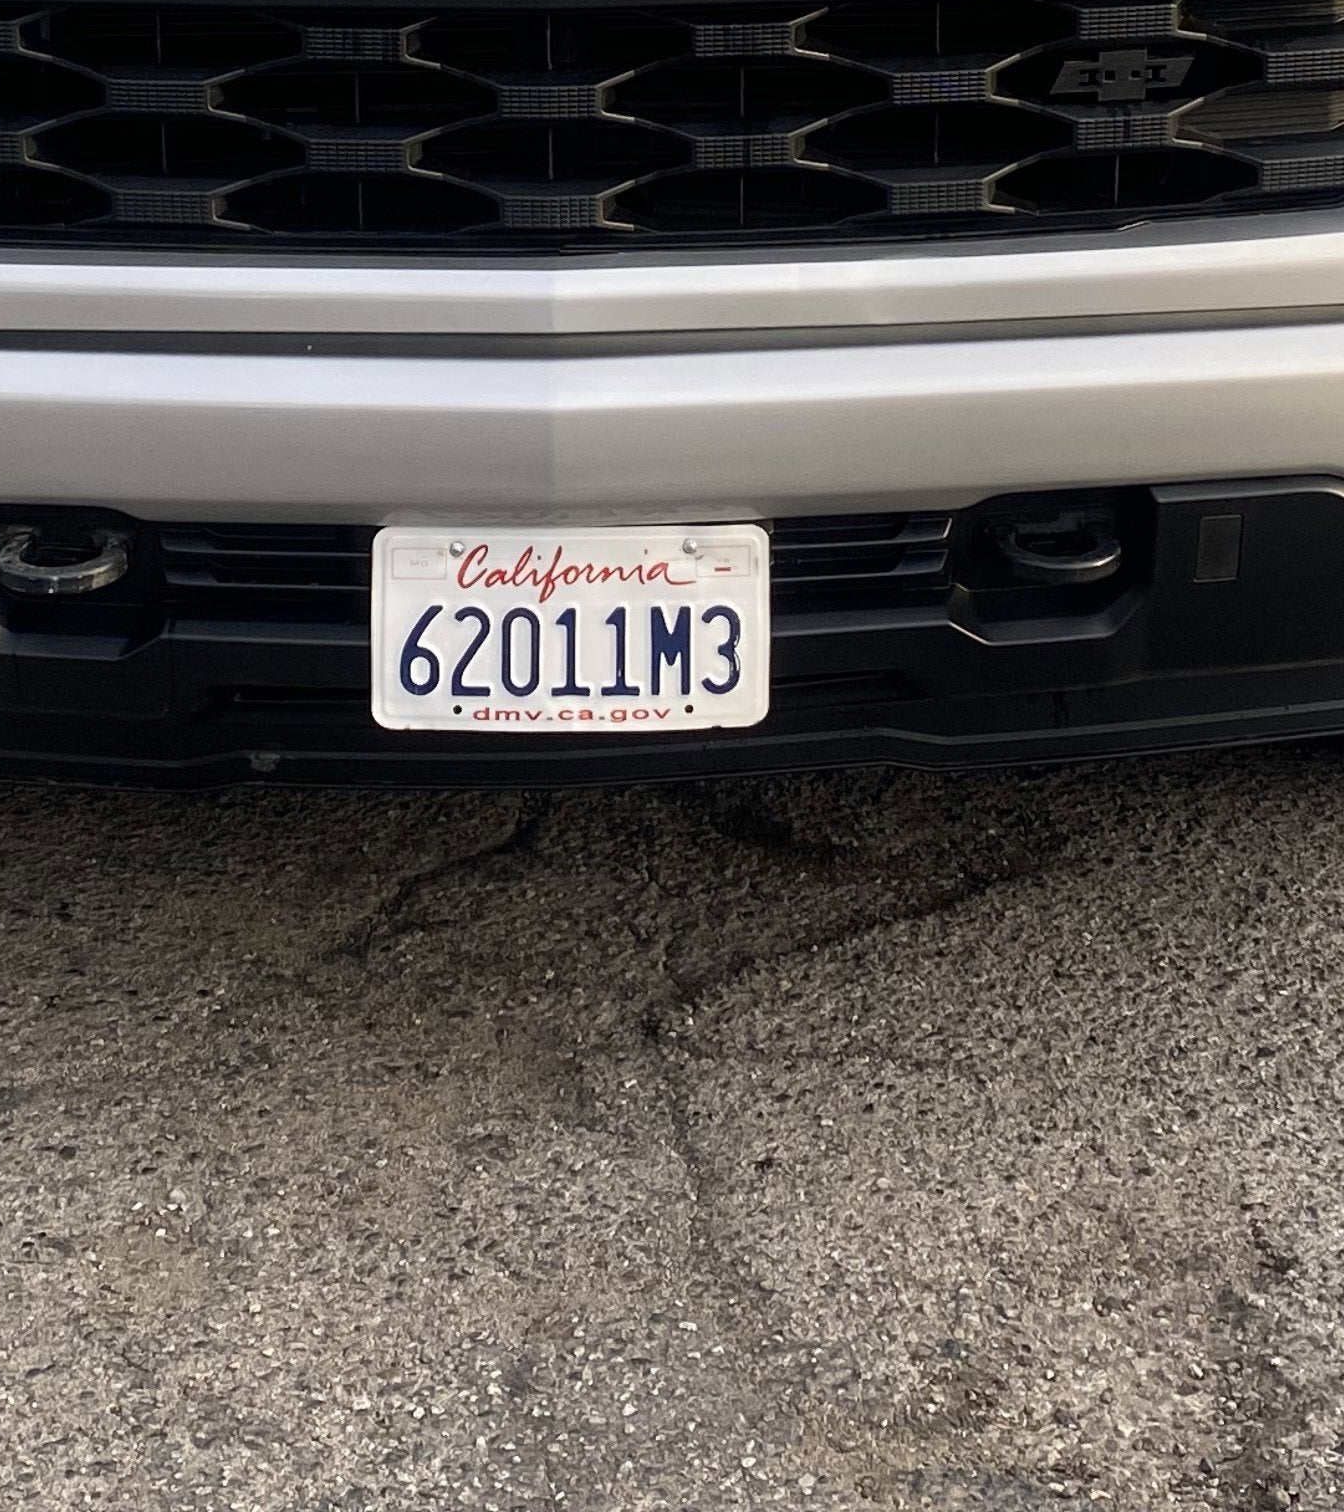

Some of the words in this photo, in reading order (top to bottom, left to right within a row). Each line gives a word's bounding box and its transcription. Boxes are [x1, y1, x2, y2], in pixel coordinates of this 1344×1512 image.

[456, 542, 698, 603] California
[399, 604, 741, 698] 62011M3
[472, 705, 672, 722] dmv.ca.gov
